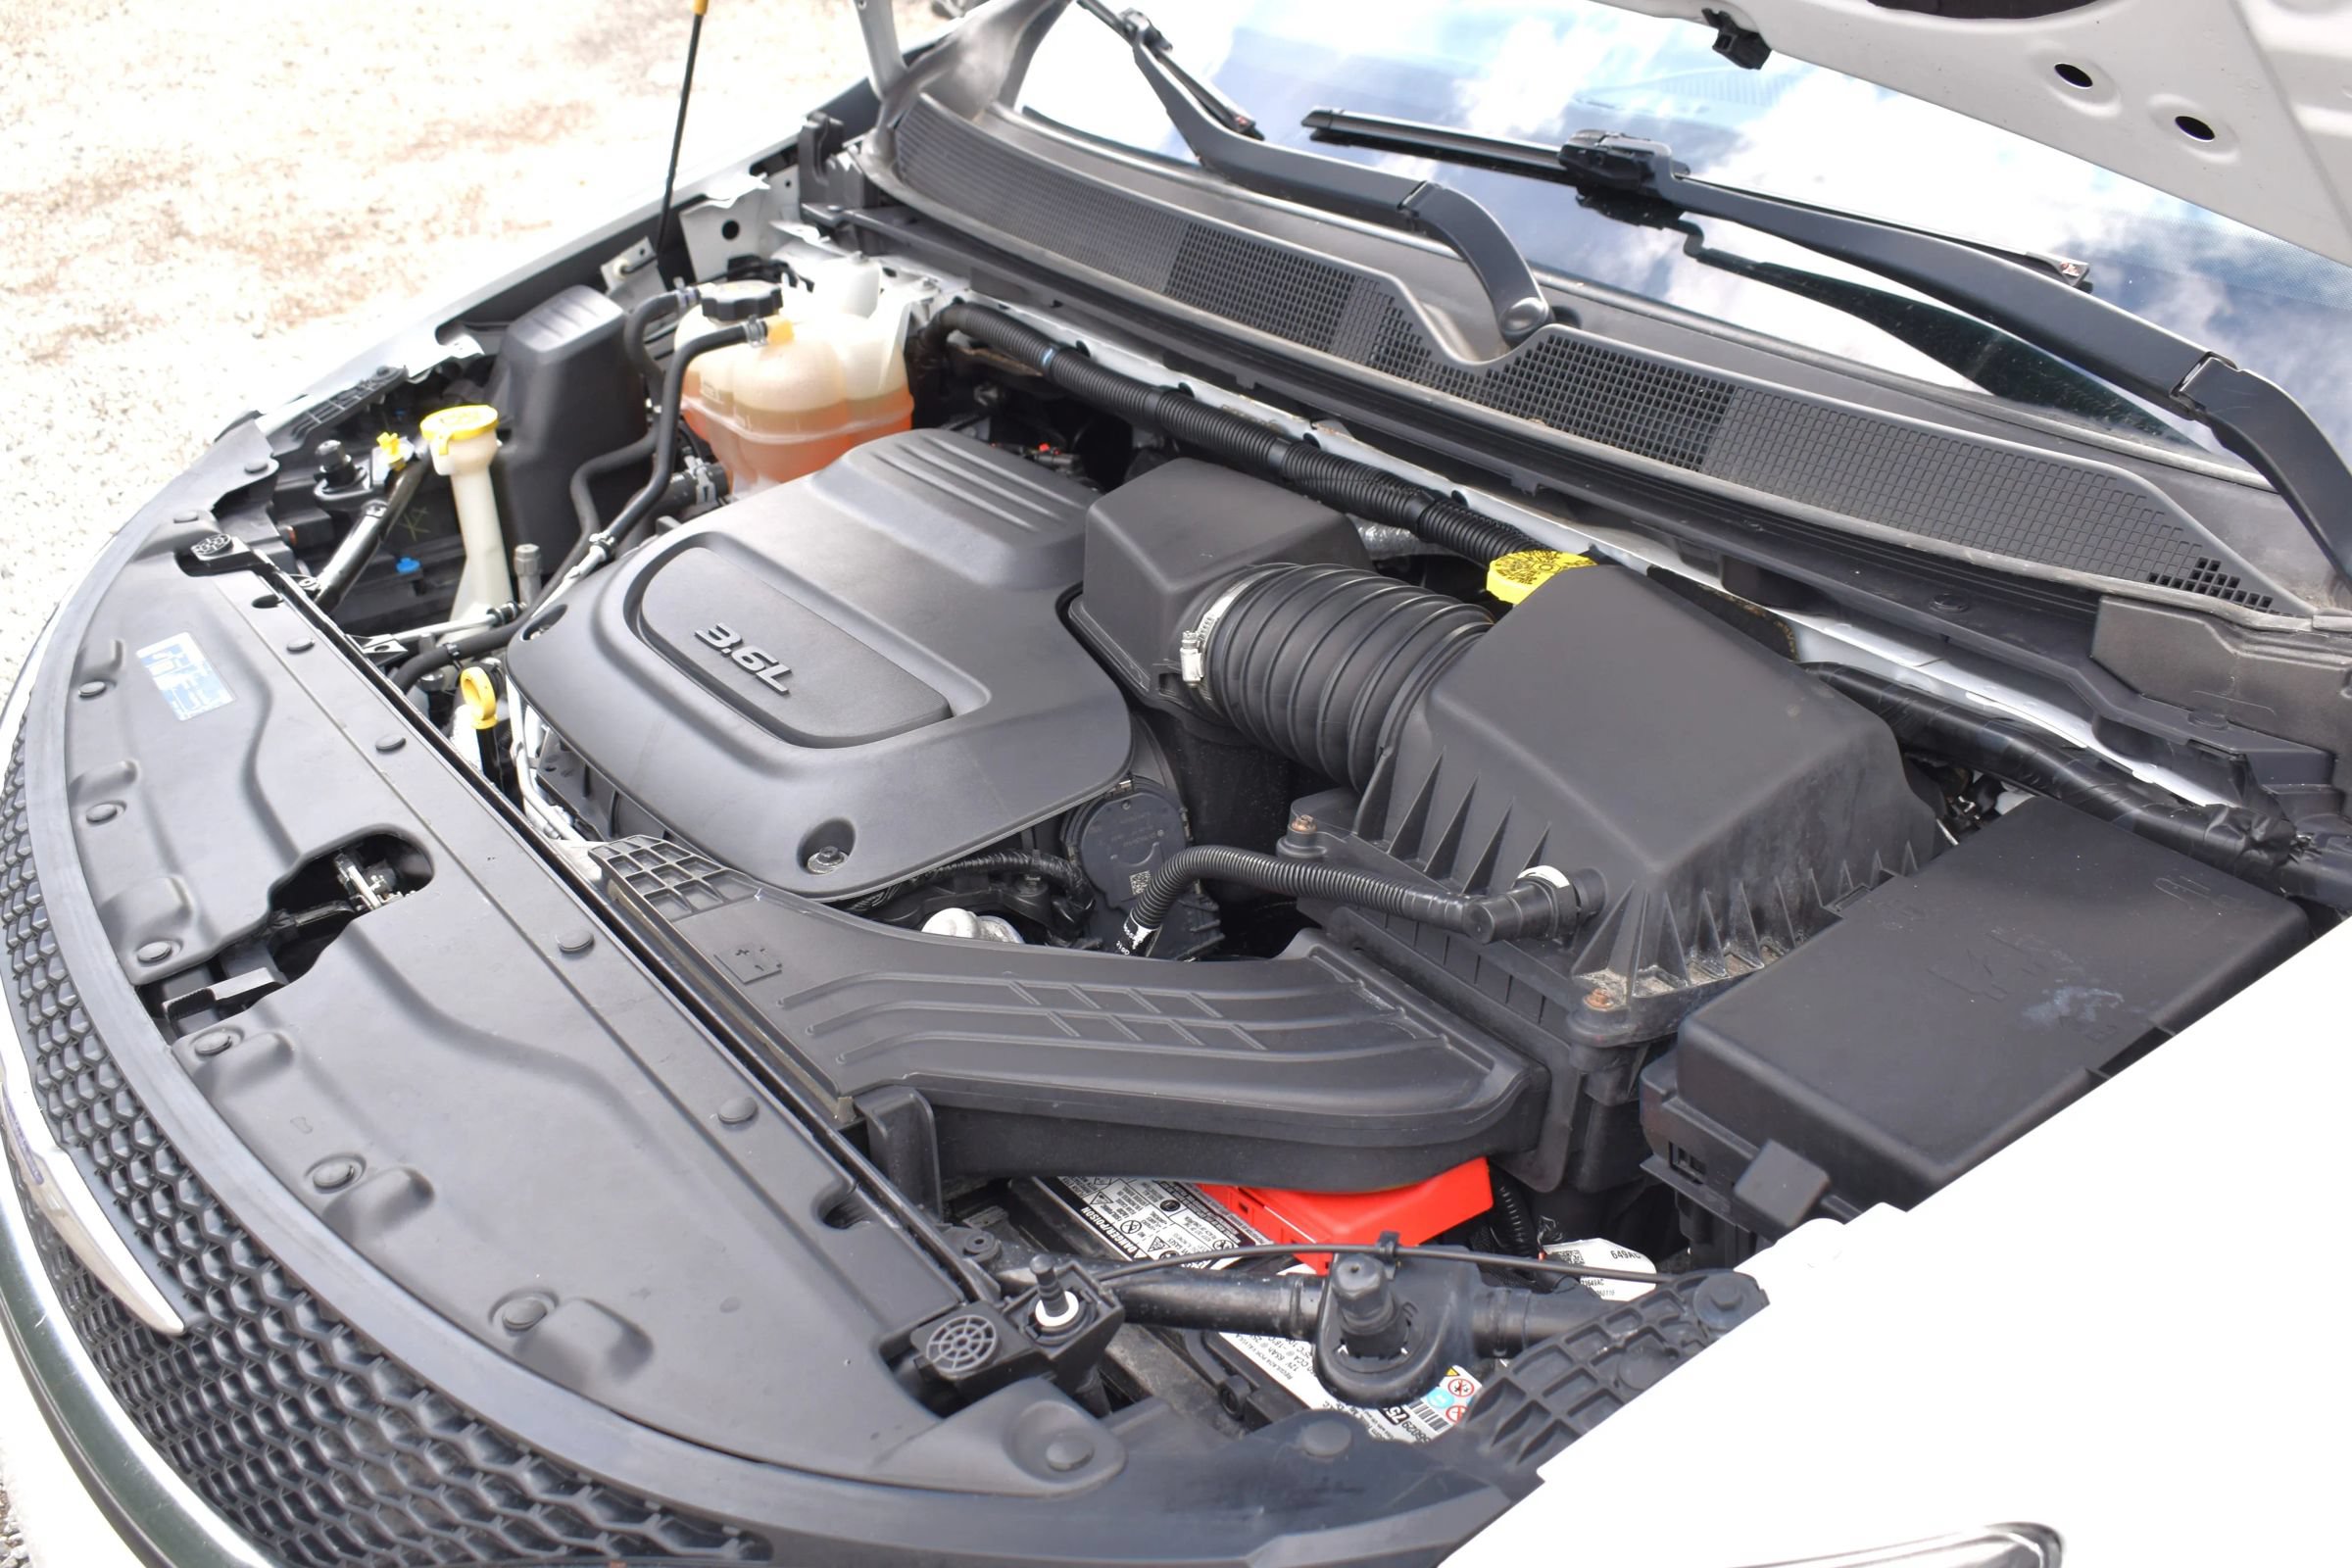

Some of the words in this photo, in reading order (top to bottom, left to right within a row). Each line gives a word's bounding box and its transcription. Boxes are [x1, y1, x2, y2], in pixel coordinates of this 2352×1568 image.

[694, 621, 792, 696] 3.6L
[1080, 1206, 1138, 1254] DANGER/POISON
[1610, 1250, 1642, 1259] 649AC
